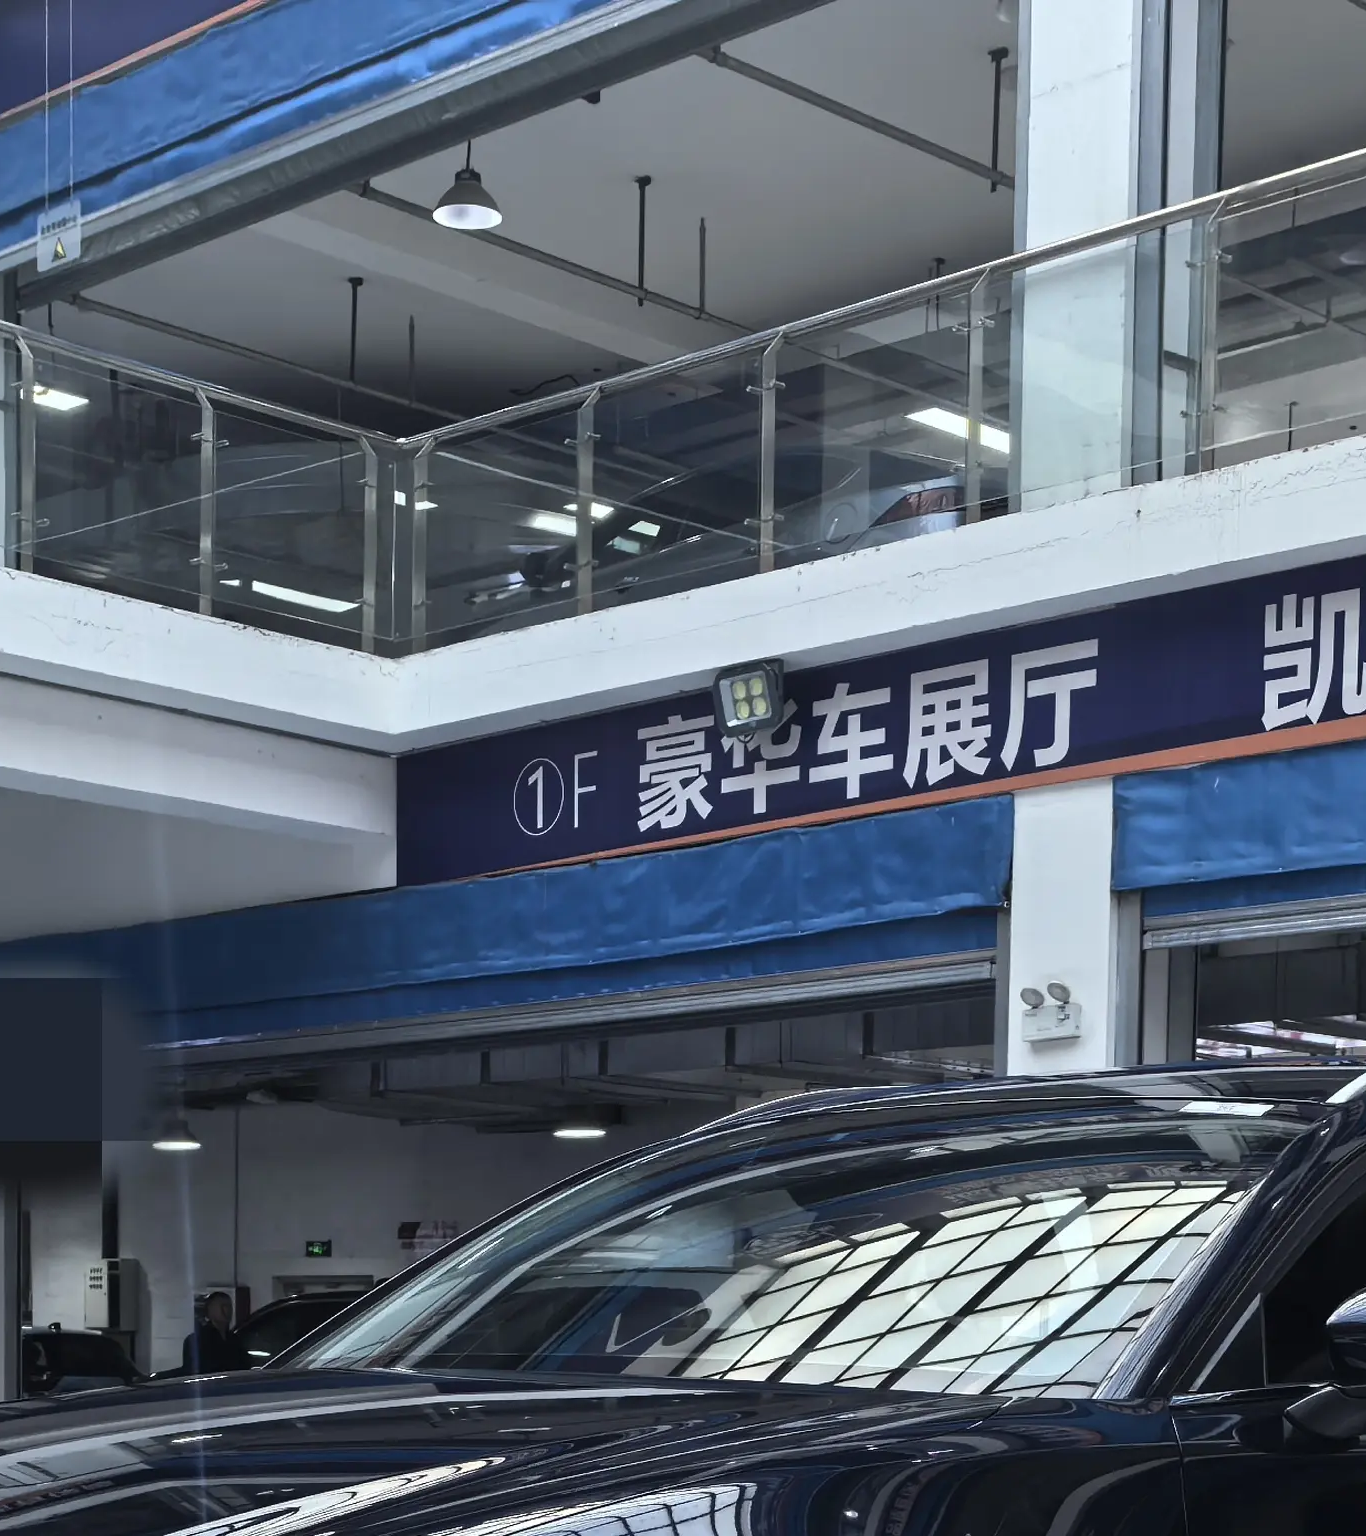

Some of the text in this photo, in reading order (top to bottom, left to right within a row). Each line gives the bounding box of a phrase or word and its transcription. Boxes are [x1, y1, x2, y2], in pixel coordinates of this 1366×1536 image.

[636, 637, 1099, 834] 豪华车展厅
